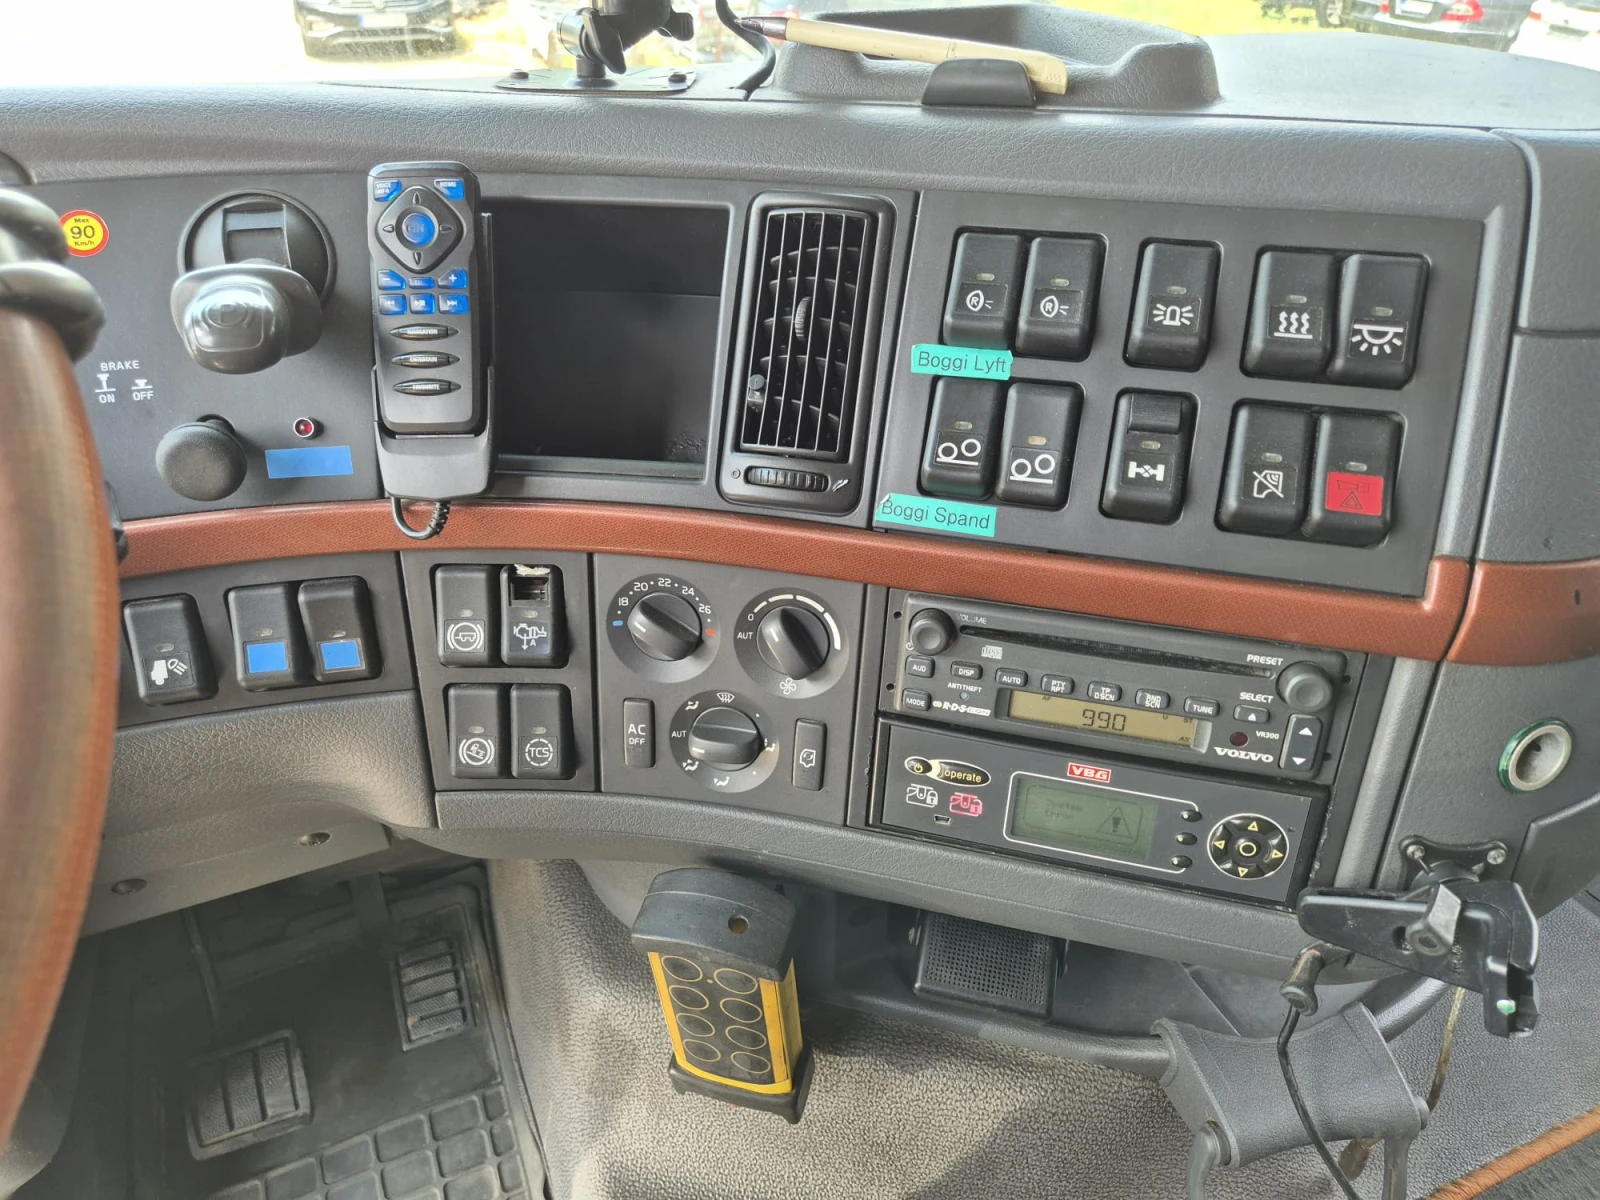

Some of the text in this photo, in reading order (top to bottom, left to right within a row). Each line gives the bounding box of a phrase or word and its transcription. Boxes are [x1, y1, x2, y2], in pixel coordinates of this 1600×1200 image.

[70, 225, 95, 239] 90
[970, 296, 979, 306] R
[1044, 302, 1054, 312] R
[100, 360, 140, 371] BRAKE
[918, 351, 1007, 373] Boggi Lyft
[99, 393, 115, 403] ON
[132, 391, 154, 401] OFF
[881, 501, 990, 529] Boggi Spand
[633, 582, 649, 591] 20
[657, 578, 672, 587] 22
[681, 586, 695, 596] 24
[618, 597, 629, 606] 18
[698, 603, 712, 615] 26
[736, 631, 754, 640] AUT
[1246, 653, 1284, 667] PRESET
[912, 664, 927, 673] AUD
[958, 668, 975, 677] DISP
[1002, 675, 1022, 685] AUTO
[1051, 680, 1066, 688] PTY
[906, 697, 925, 707] MODE
[1239, 691, 1274, 704] SELECT
[1145, 700, 1161, 709] SCN
[1192, 704, 1214, 714] TUNE
[1082, 708, 1127, 732] 990
[627, 723, 647, 736] AC
[671, 730, 687, 738] AUT
[1255, 730, 1280, 740] VR300
[628, 737, 646, 745] OFF
[529, 747, 550, 758] TCS
[1213, 746, 1274, 763] VOLVO
[944, 770, 982, 783] operate
[1069, 765, 1109, 781] VBG
